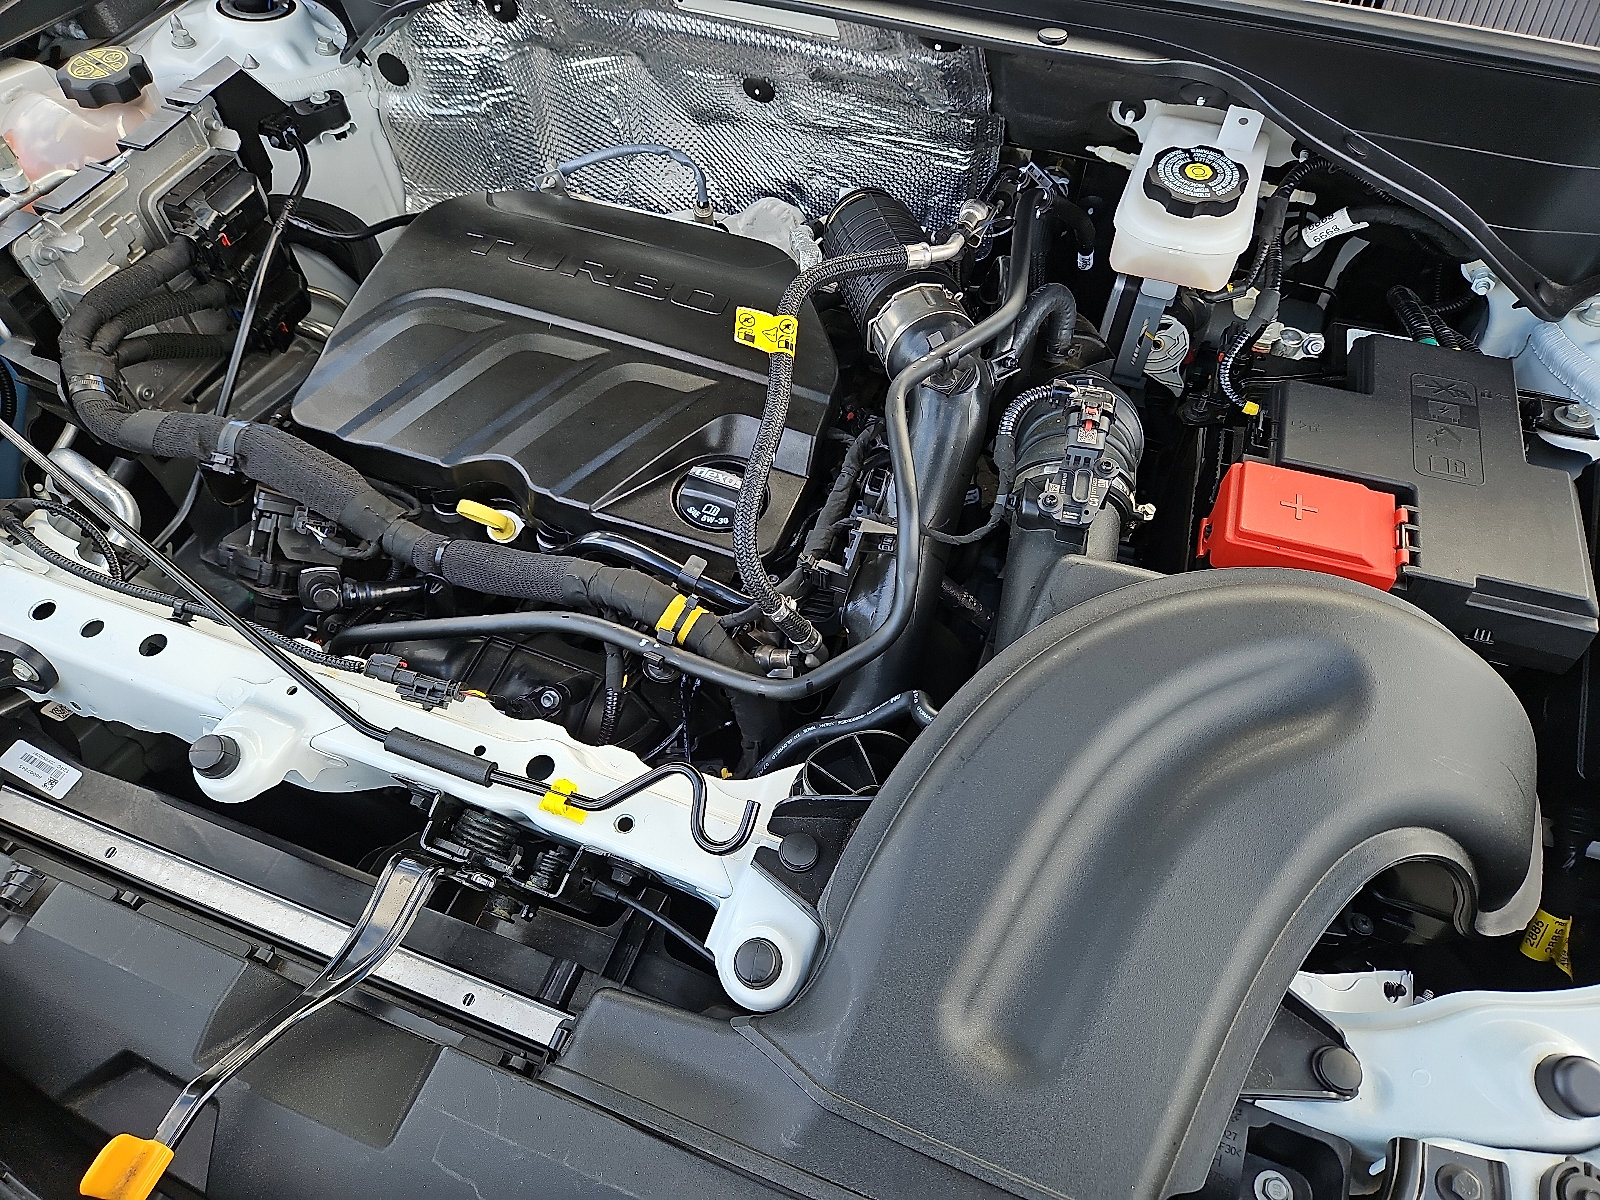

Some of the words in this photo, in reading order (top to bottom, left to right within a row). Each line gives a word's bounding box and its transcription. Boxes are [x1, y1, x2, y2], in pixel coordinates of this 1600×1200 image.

[466, 231, 732, 315] TURBO
[686, 506, 702, 519] SAE
[1525, 918, 1545, 948] 2885
